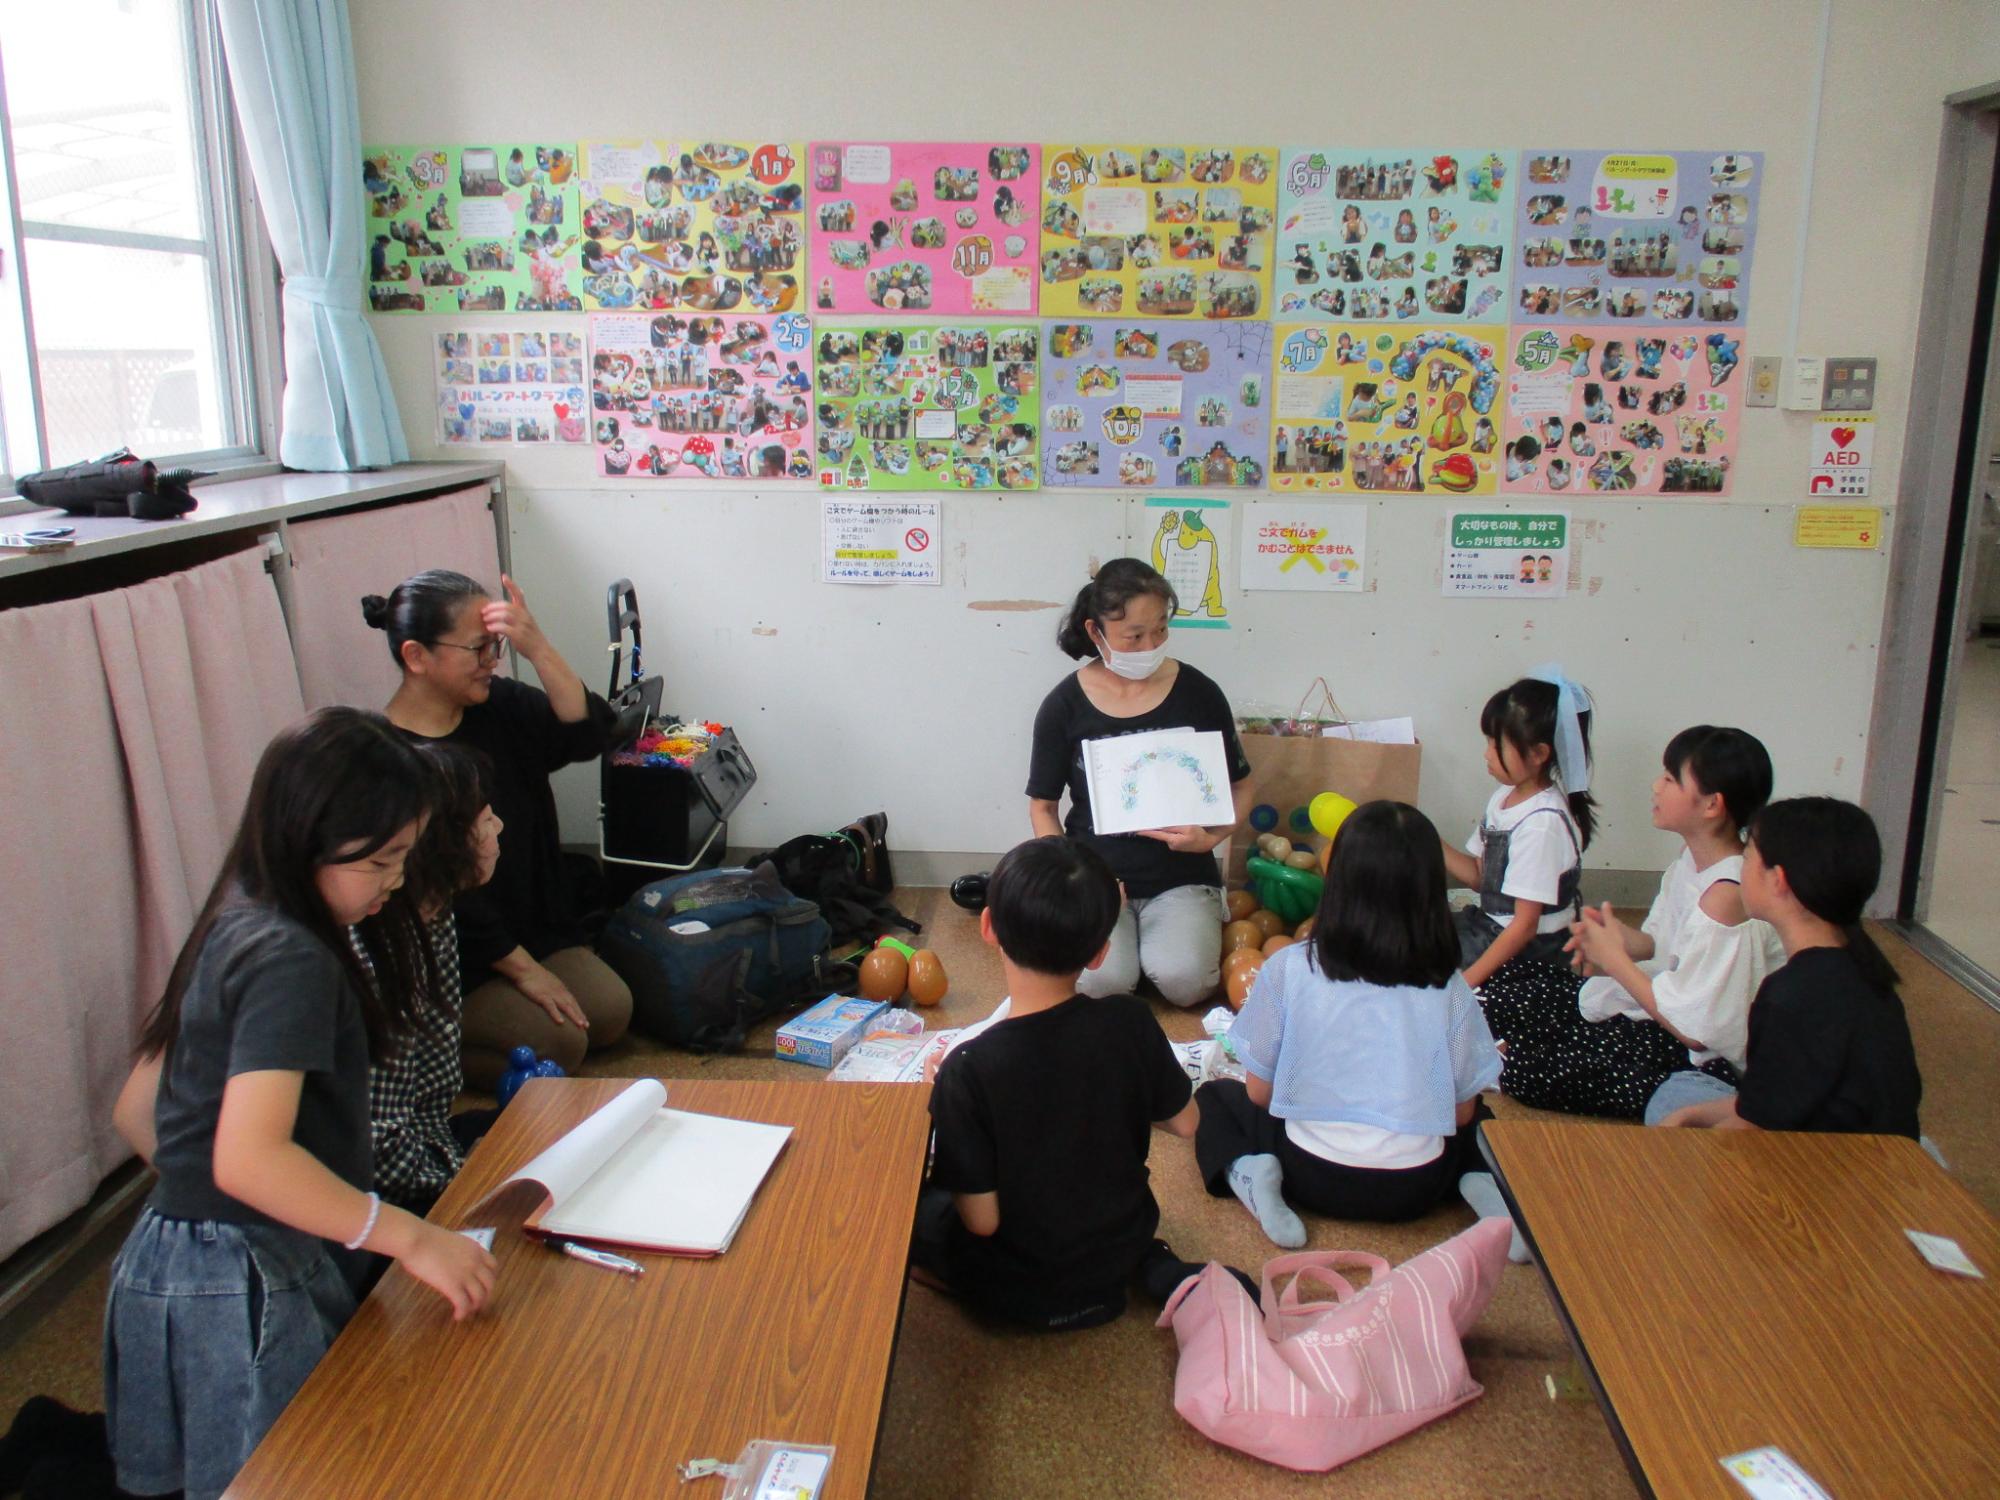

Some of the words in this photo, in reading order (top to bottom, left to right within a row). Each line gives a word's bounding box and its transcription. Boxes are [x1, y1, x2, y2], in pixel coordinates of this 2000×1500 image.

[419, 158, 444, 184] 3月
[760, 154, 783, 176] 1月
[1055, 161, 1086, 184] 9月
[1292, 162, 1321, 188] 6月
[958, 244, 990, 267] 11月
[776, 319, 804, 349] 2月
[1289, 342, 1316, 365] 7月
[1524, 340, 1552, 365] 5月
[460, 391, 566, 401] バルーンアートクラブ
[940, 376, 972, 405] 12月
[1102, 418, 1139, 440] 10月
[1823, 451, 1861, 465] AED
[1258, 527, 1318, 538] こ文でガムを
[1460, 520, 1558, 531] 大切なものは、自分で
[1257, 543, 1355, 554] かむことはできません
[1455, 537, 1561, 546] しっかり管理しましょう
